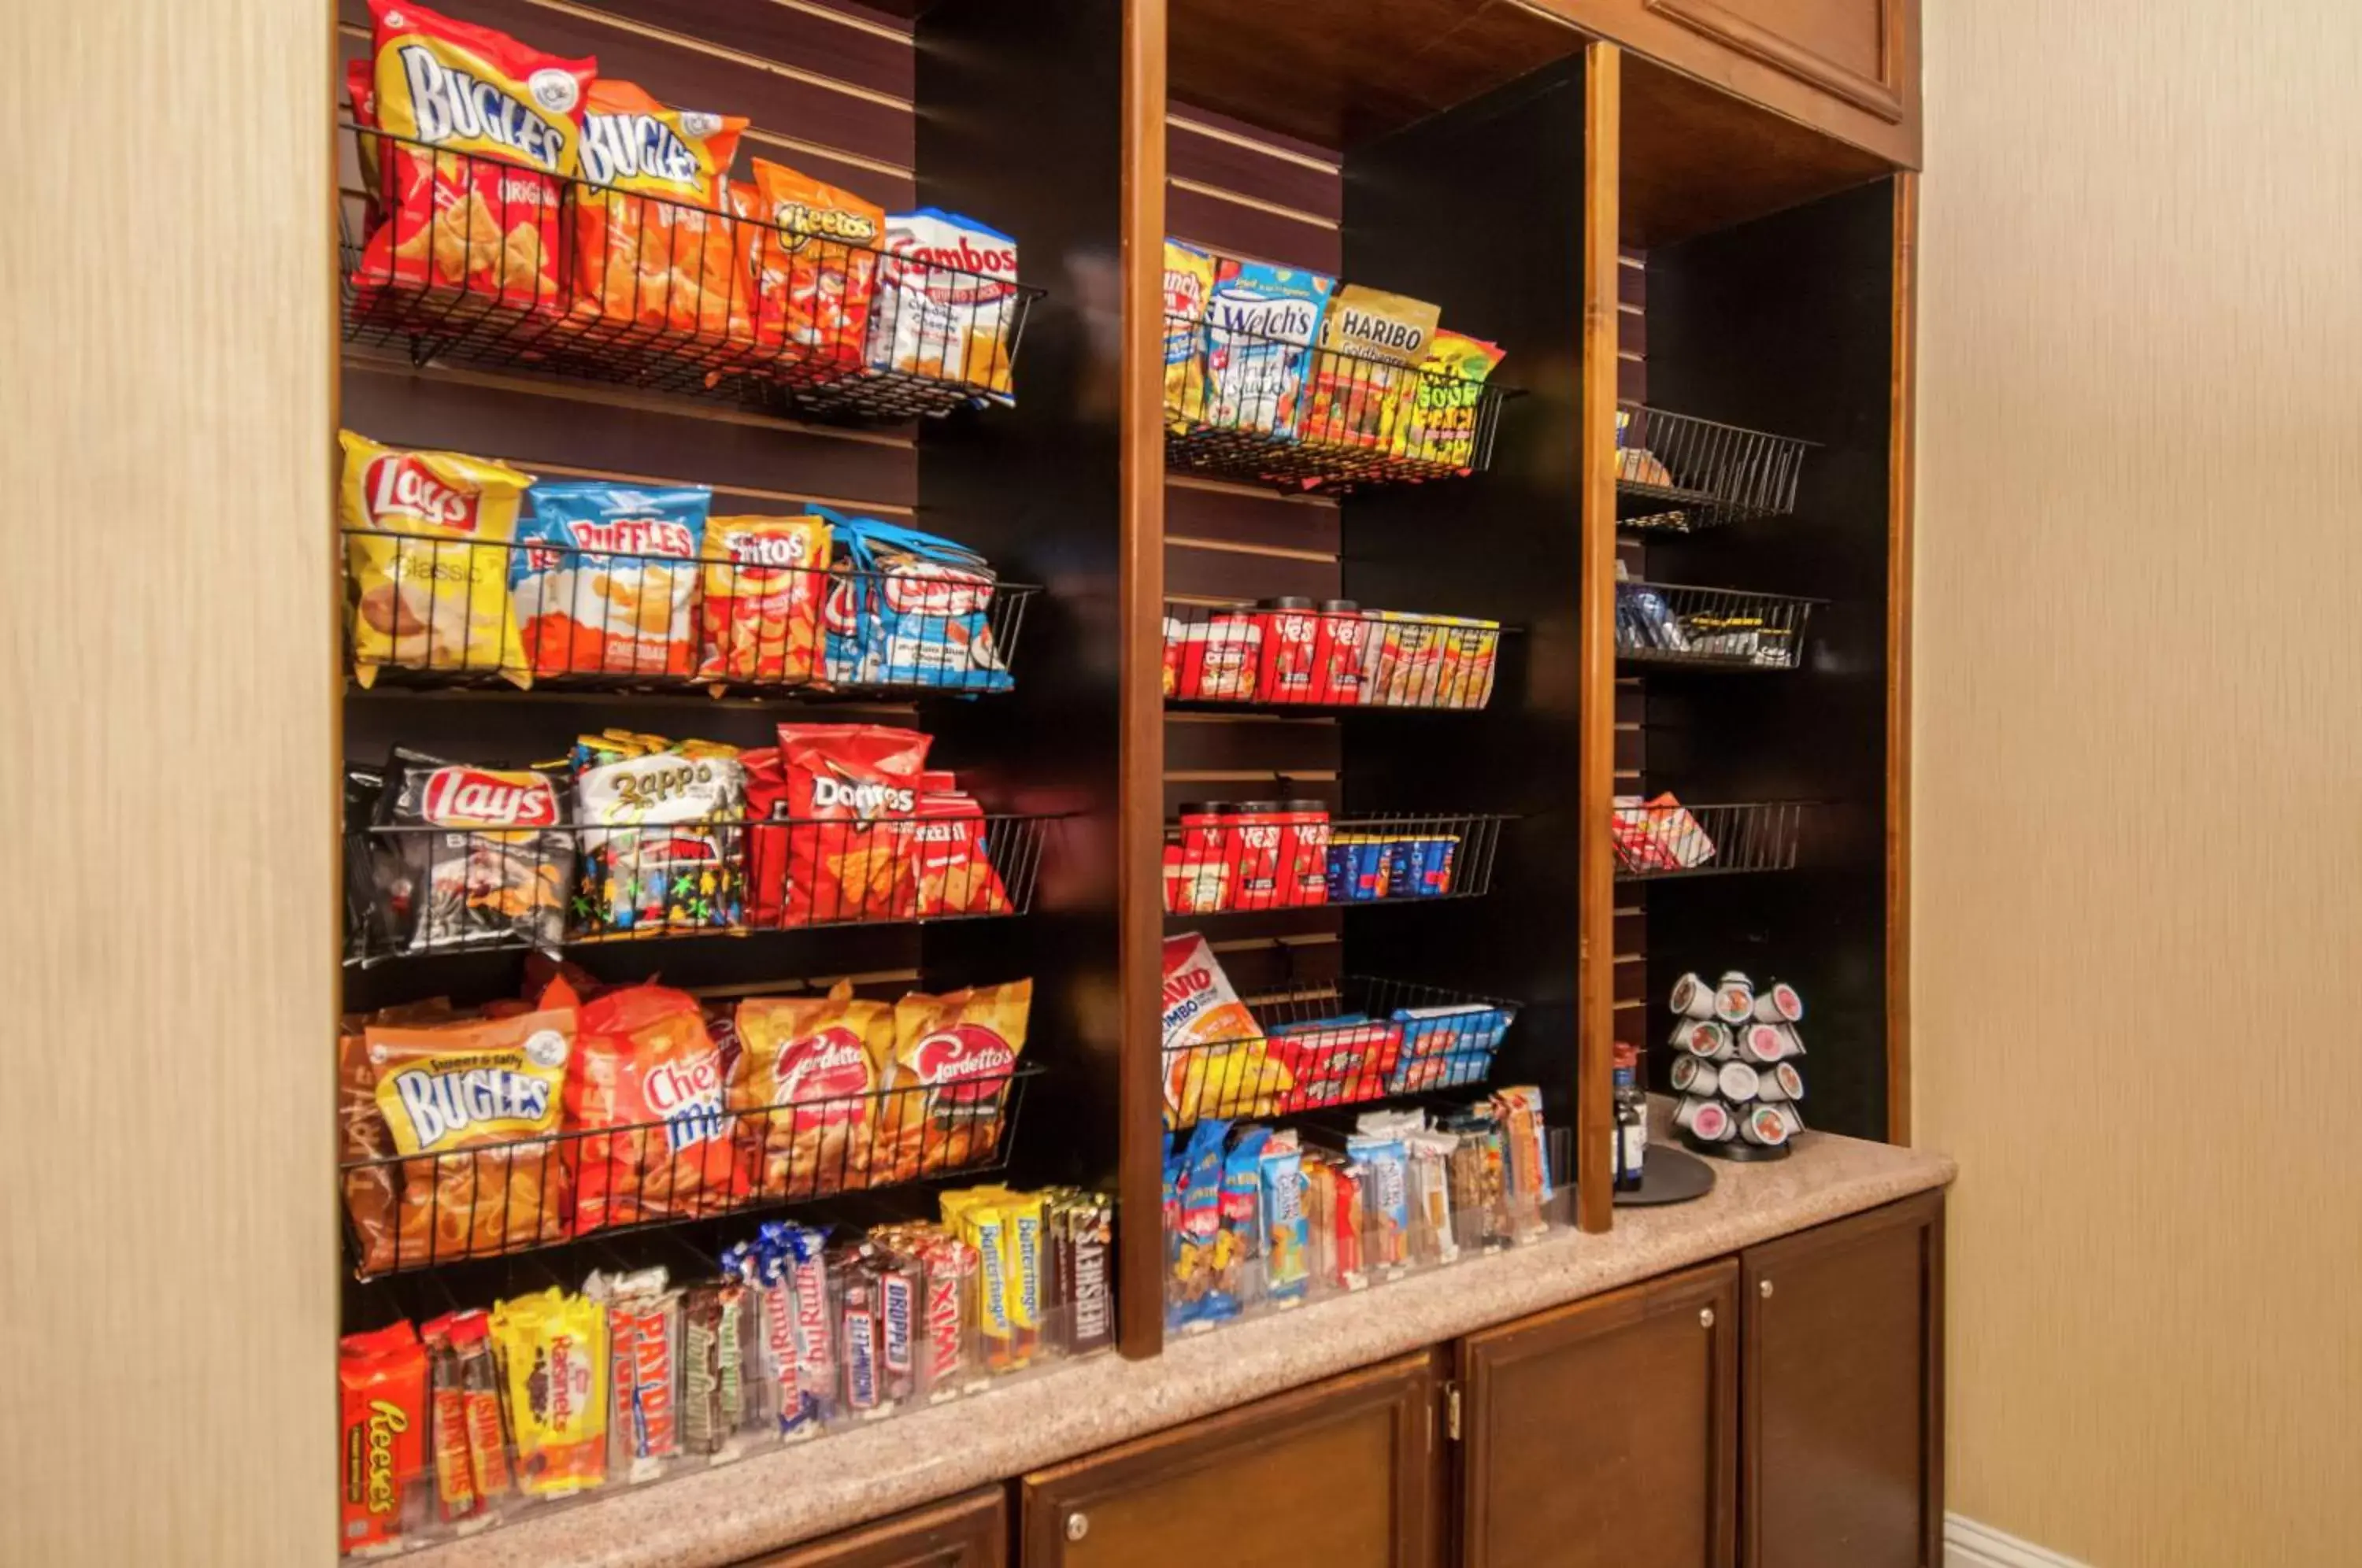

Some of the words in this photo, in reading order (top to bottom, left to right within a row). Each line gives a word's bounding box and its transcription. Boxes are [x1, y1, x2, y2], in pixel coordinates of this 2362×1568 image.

[398, 44, 565, 175] BUGLES
[775, 203, 874, 251] Cheetos
[890, 235, 1018, 276] Combos
[1222, 302, 1311, 337] Welch's
[1342, 310, 1422, 351] HARIBO
[814, 773, 915, 814] Doritos
[913, 1033, 1014, 1098] Gardetto's
[395, 1068, 550, 1150] BUGLES
[1076, 1230, 1105, 1339] HERSHEY'S
[929, 1281, 959, 1378] TWIX
[368, 1400, 409, 1514] Reese's
